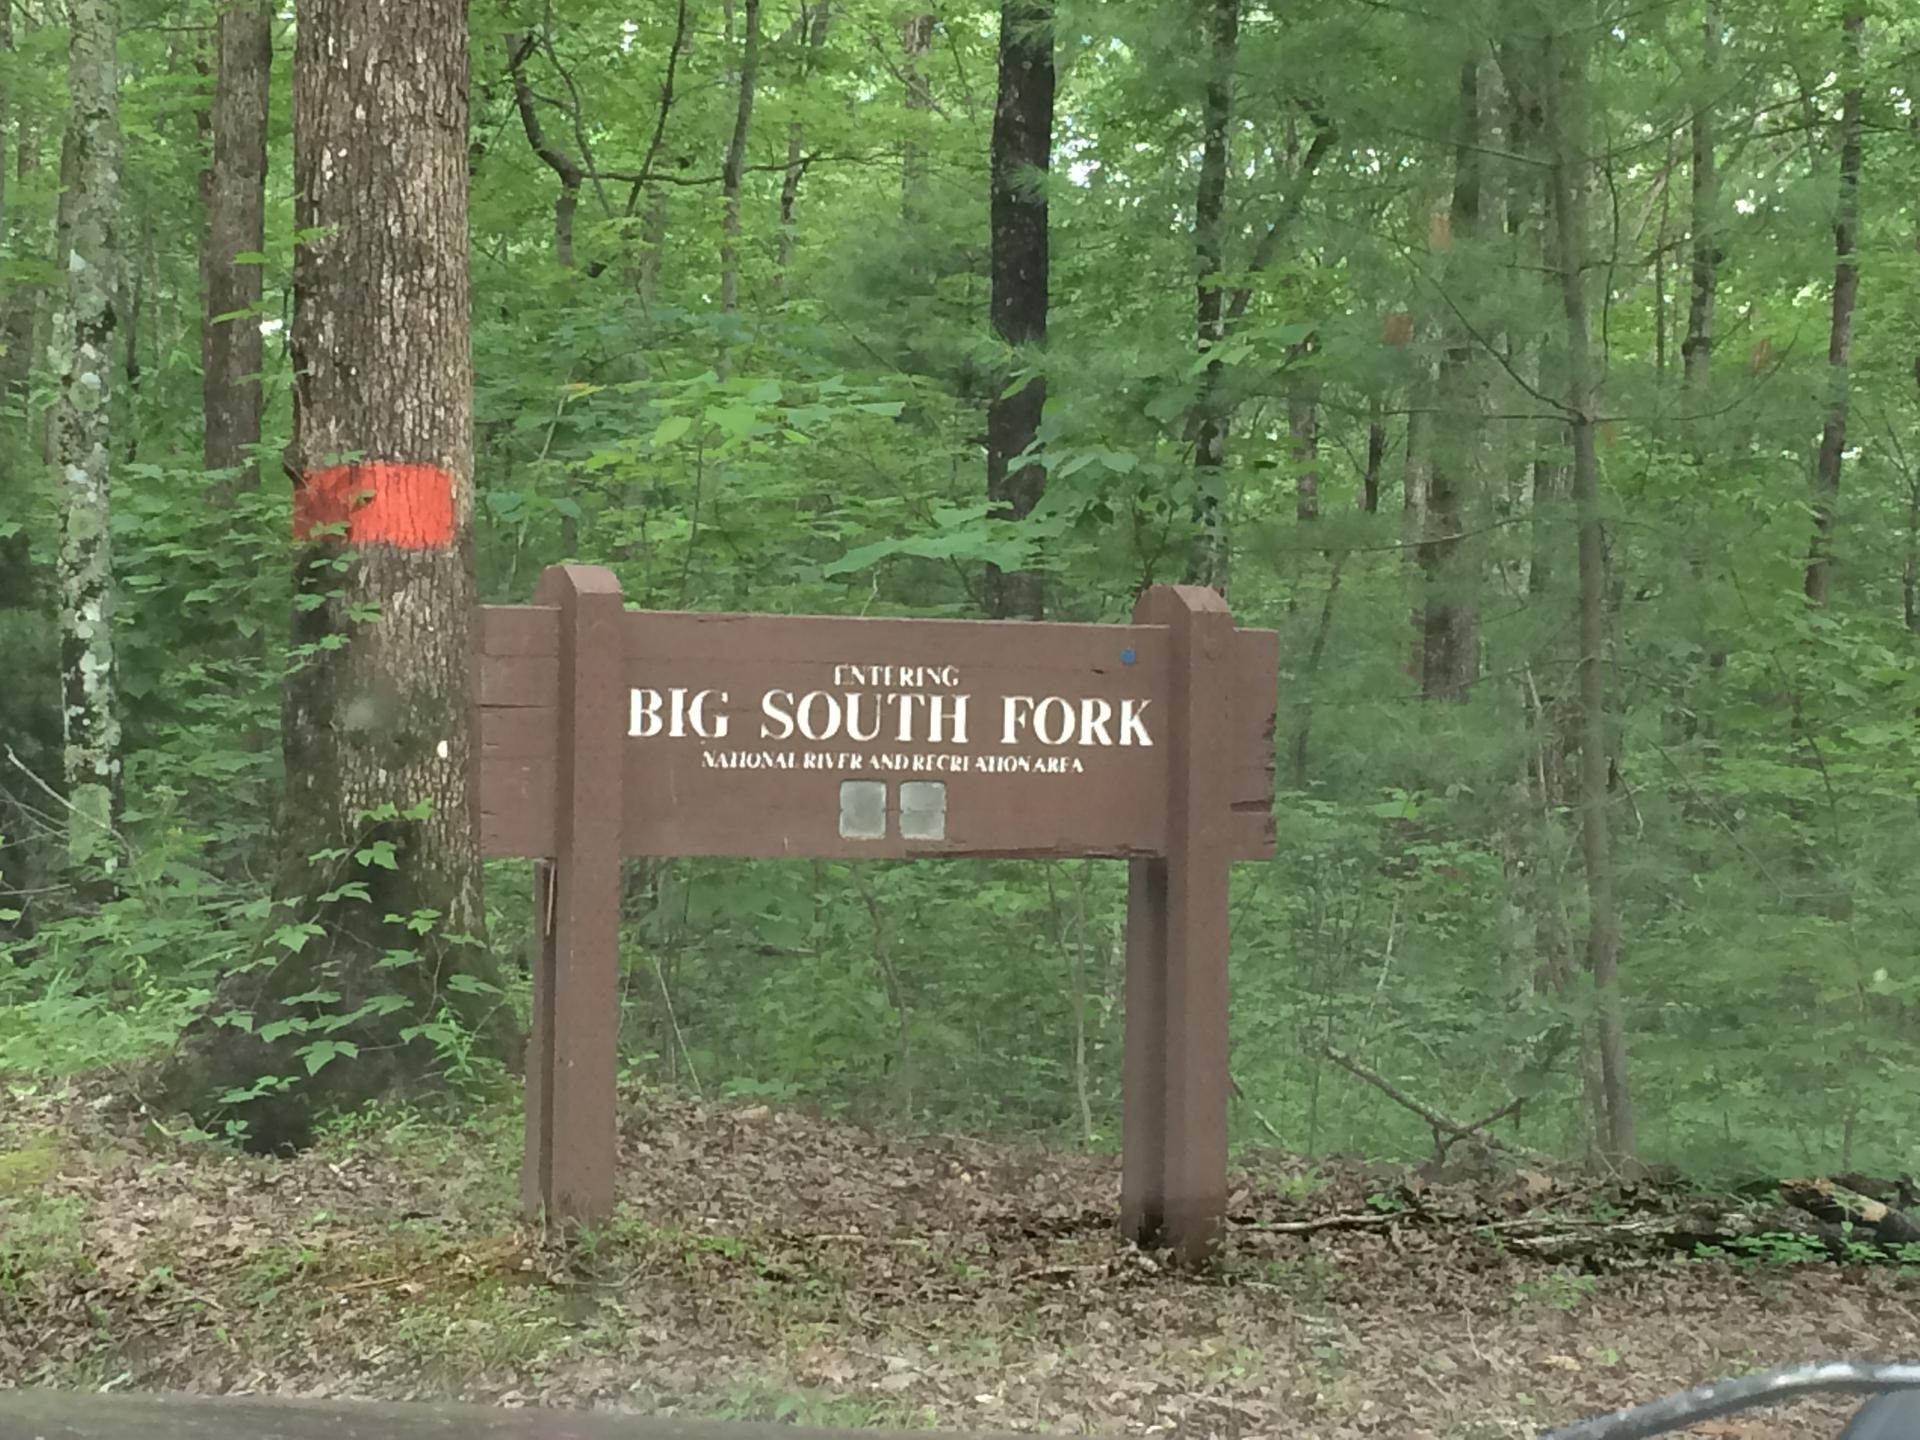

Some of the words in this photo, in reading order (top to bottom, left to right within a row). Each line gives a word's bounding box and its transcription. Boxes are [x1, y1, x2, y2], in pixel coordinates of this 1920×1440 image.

[834, 664, 960, 687] ENTERING
[627, 687, 729, 738] BIG
[760, 688, 971, 743] SOUTH
[1000, 695, 1154, 746] FORK
[702, 750, 798, 769] NATIONAL
[803, 752, 863, 770] RIVER
[869, 753, 908, 771] AND
[1032, 756, 1085, 774] AREA
